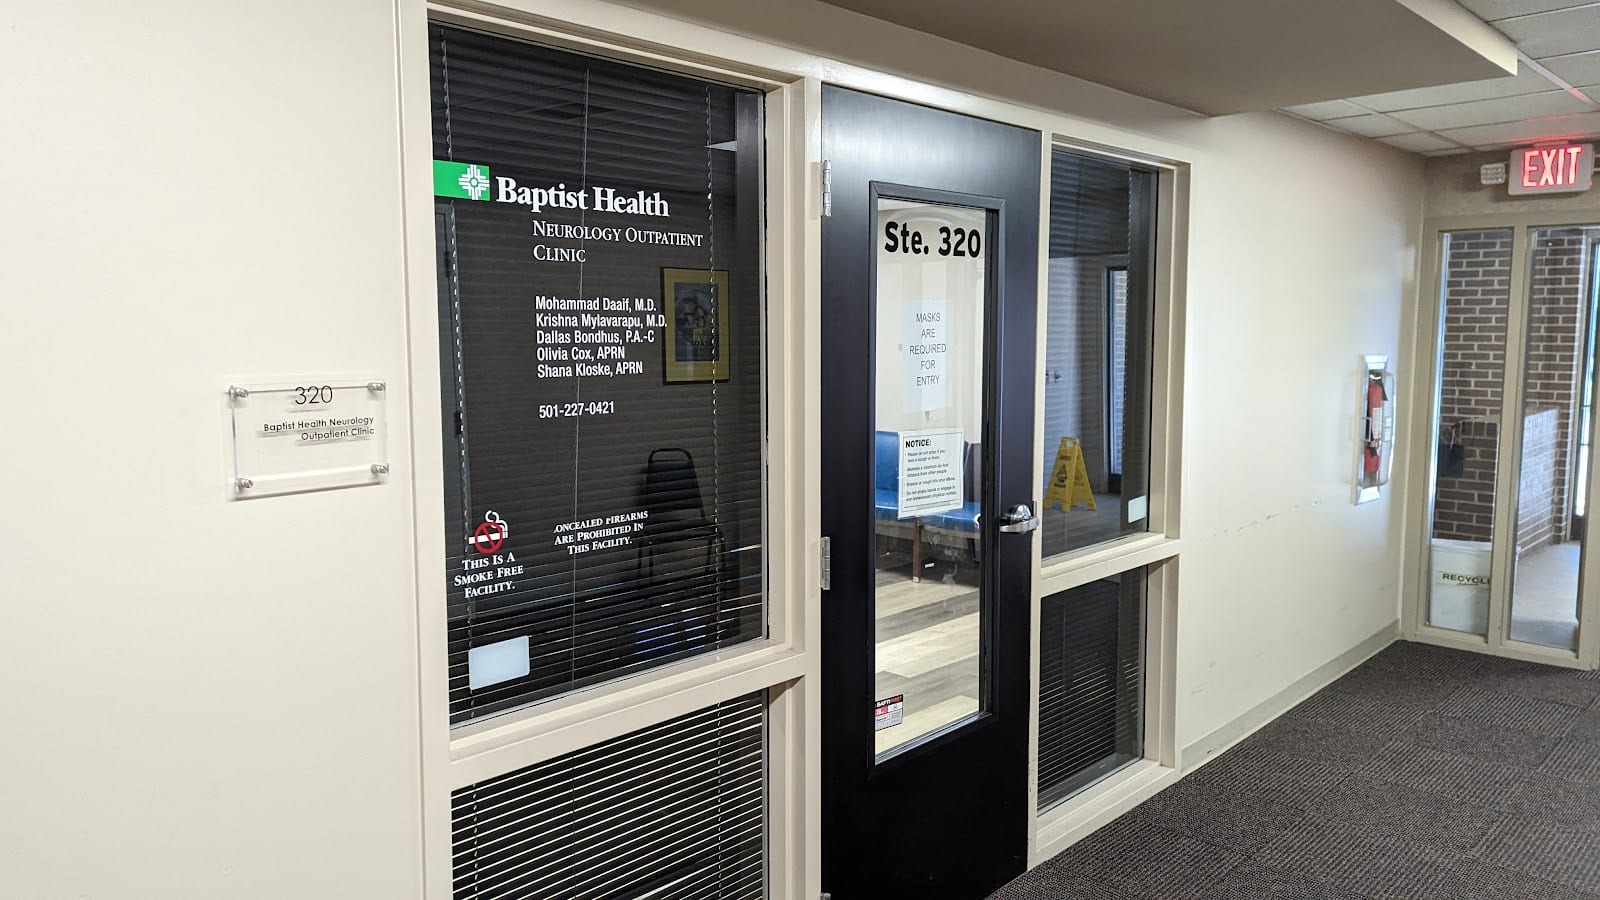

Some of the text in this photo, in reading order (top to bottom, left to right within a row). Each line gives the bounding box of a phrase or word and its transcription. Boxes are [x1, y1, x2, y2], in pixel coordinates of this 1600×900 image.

[1522, 146, 1582, 188] EXIT
[496, 176, 670, 217] Baptist Health
[532, 220, 704, 247] NEUROLOGY OUTPATIENT
[884, 221, 981, 258] Ste. 320
[533, 244, 586, 262] CLINIC
[535, 296, 656, 312] Mohammad Daaif, M.D.
[536, 313, 668, 330] Krishna Mylavarapu, M.D.
[916, 312, 941, 323] MASKS
[536, 330, 655, 345] Dallas Bondhus, P.A.-C
[920, 328, 936, 338] ARE
[536, 346, 626, 362] Olivia Cox, APRN
[909, 343, 947, 355] REQUIRED
[537, 360, 644, 378] Shana Kloske, APRN
[920, 360, 936, 370] FOR
[916, 375, 940, 386] ENTRY
[294, 385, 333, 405] 320
[539, 400, 614, 418] 501-227-0421
[264, 416, 374, 433] Baptist Health Neurology
[301, 427, 375, 441] Outpatient Clinic
[906, 439, 932, 448] NOTICE:
[554, 518, 604, 534] ONCEALED
[554, 522, 644, 546] ARE PROHIBITED IN
[567, 536, 632, 556] THIS FACILITY.
[462, 552, 516, 572] THIS IS A
[454, 564, 524, 587] SMOKE FREE
[1442, 573, 1490, 585] RECYCL
[464, 580, 516, 599] FACILITY.
